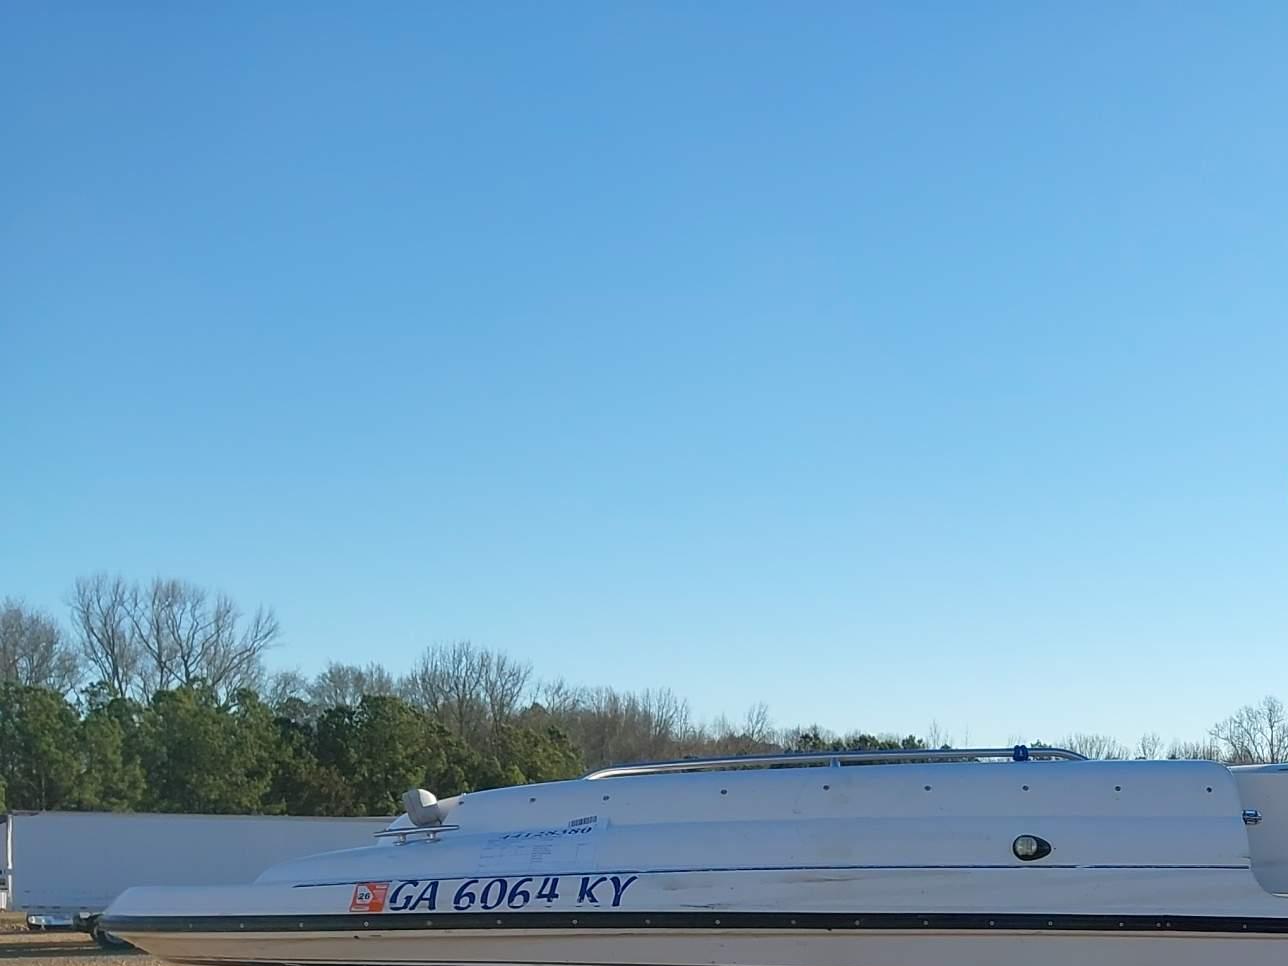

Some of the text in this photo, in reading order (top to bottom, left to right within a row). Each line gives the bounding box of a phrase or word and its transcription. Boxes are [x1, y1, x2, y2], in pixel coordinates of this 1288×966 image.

[358, 892, 370, 900] 26
[390, 876, 639, 911] GA 6064 KY
